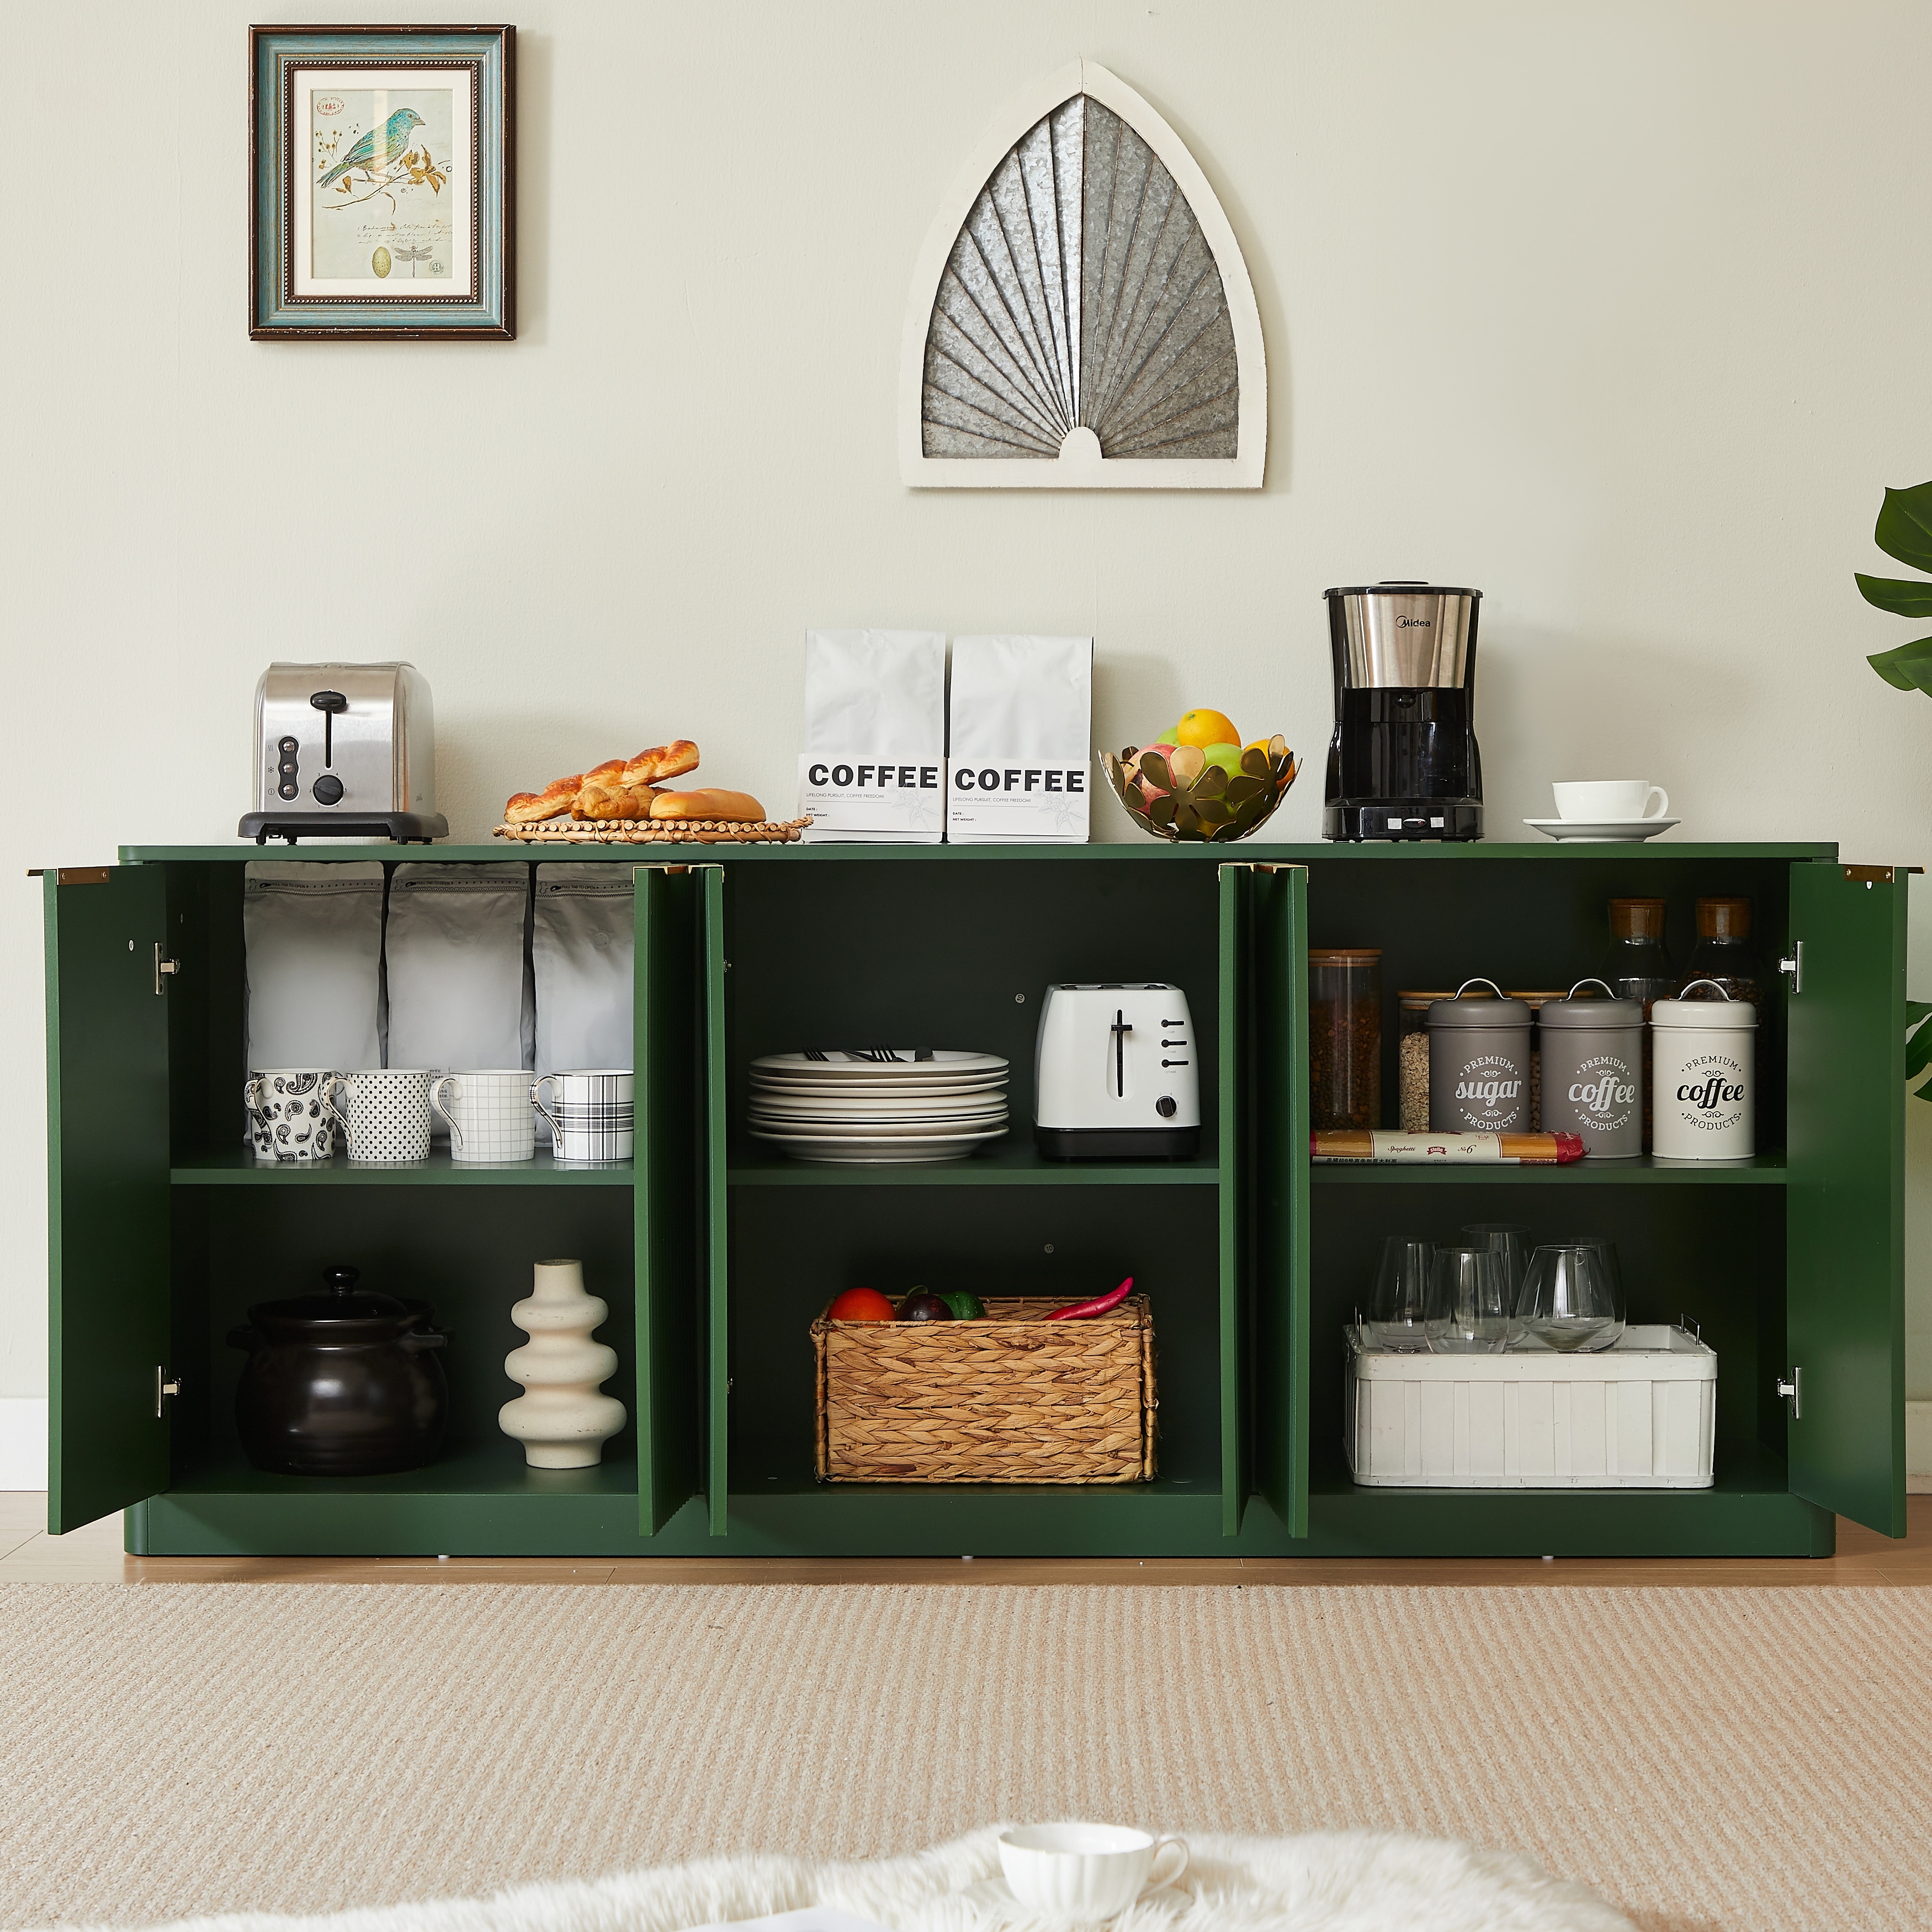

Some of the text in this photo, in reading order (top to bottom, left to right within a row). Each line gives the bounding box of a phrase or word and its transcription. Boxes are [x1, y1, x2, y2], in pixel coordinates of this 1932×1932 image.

[1396, 615, 1431, 628] Midea
[809, 765, 938, 788] COFFEE
[955, 769, 1084, 792] COFFEE
[1463, 1056, 1515, 1073] PREMIUM
[1580, 1057, 1627, 1072] PREMIUM
[1685, 1055, 1738, 1070] PREMIUM
[1455, 1080, 1522, 1107] sugar
[1568, 1076, 1635, 1111] coffee
[1676, 1078, 1745, 1109] coffee
[1464, 1111, 1517, 1130] PRODUCTS
[1579, 1113, 1633, 1130] PRODUCTS
[1684, 1113, 1740, 1130] PRODUCTS
